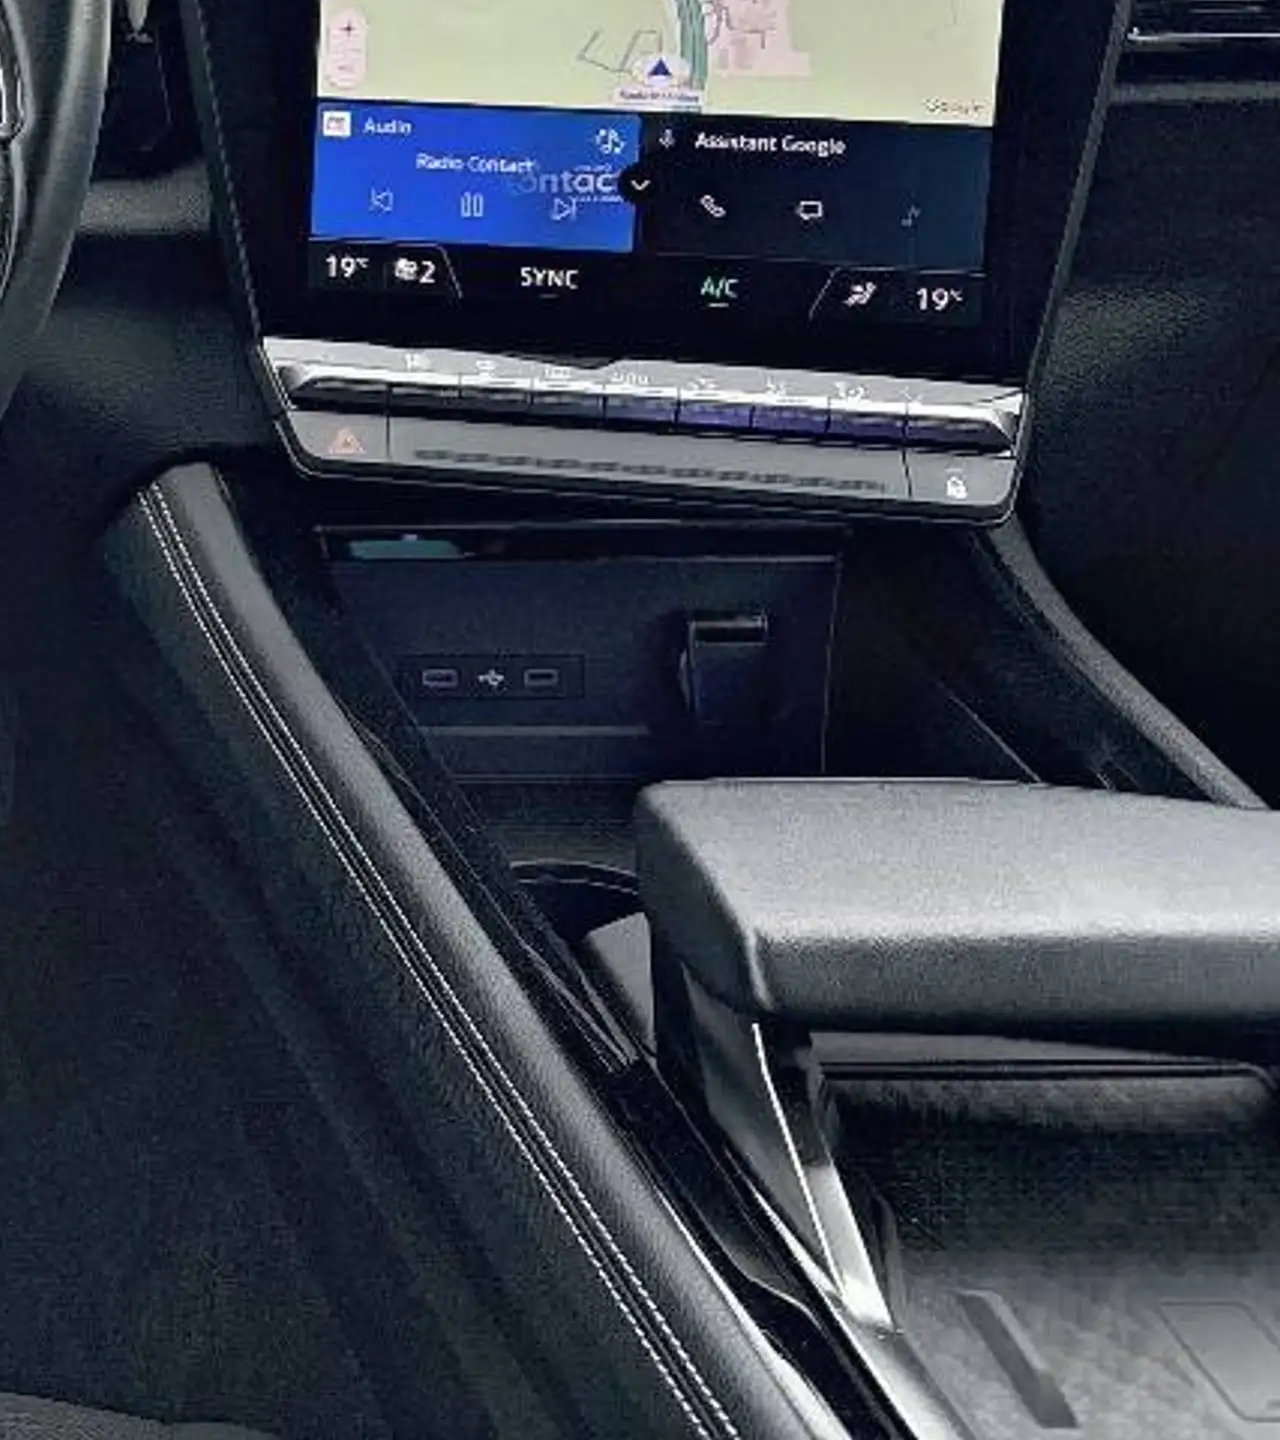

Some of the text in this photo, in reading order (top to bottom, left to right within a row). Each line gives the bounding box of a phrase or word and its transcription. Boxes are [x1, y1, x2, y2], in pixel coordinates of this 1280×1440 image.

[694, 132, 847, 157] Assistant Google
[416, 152, 463, 170] Radio
[419, 260, 437, 284] 2
[520, 266, 579, 290] SYNC
[700, 275, 739, 298] A/C
